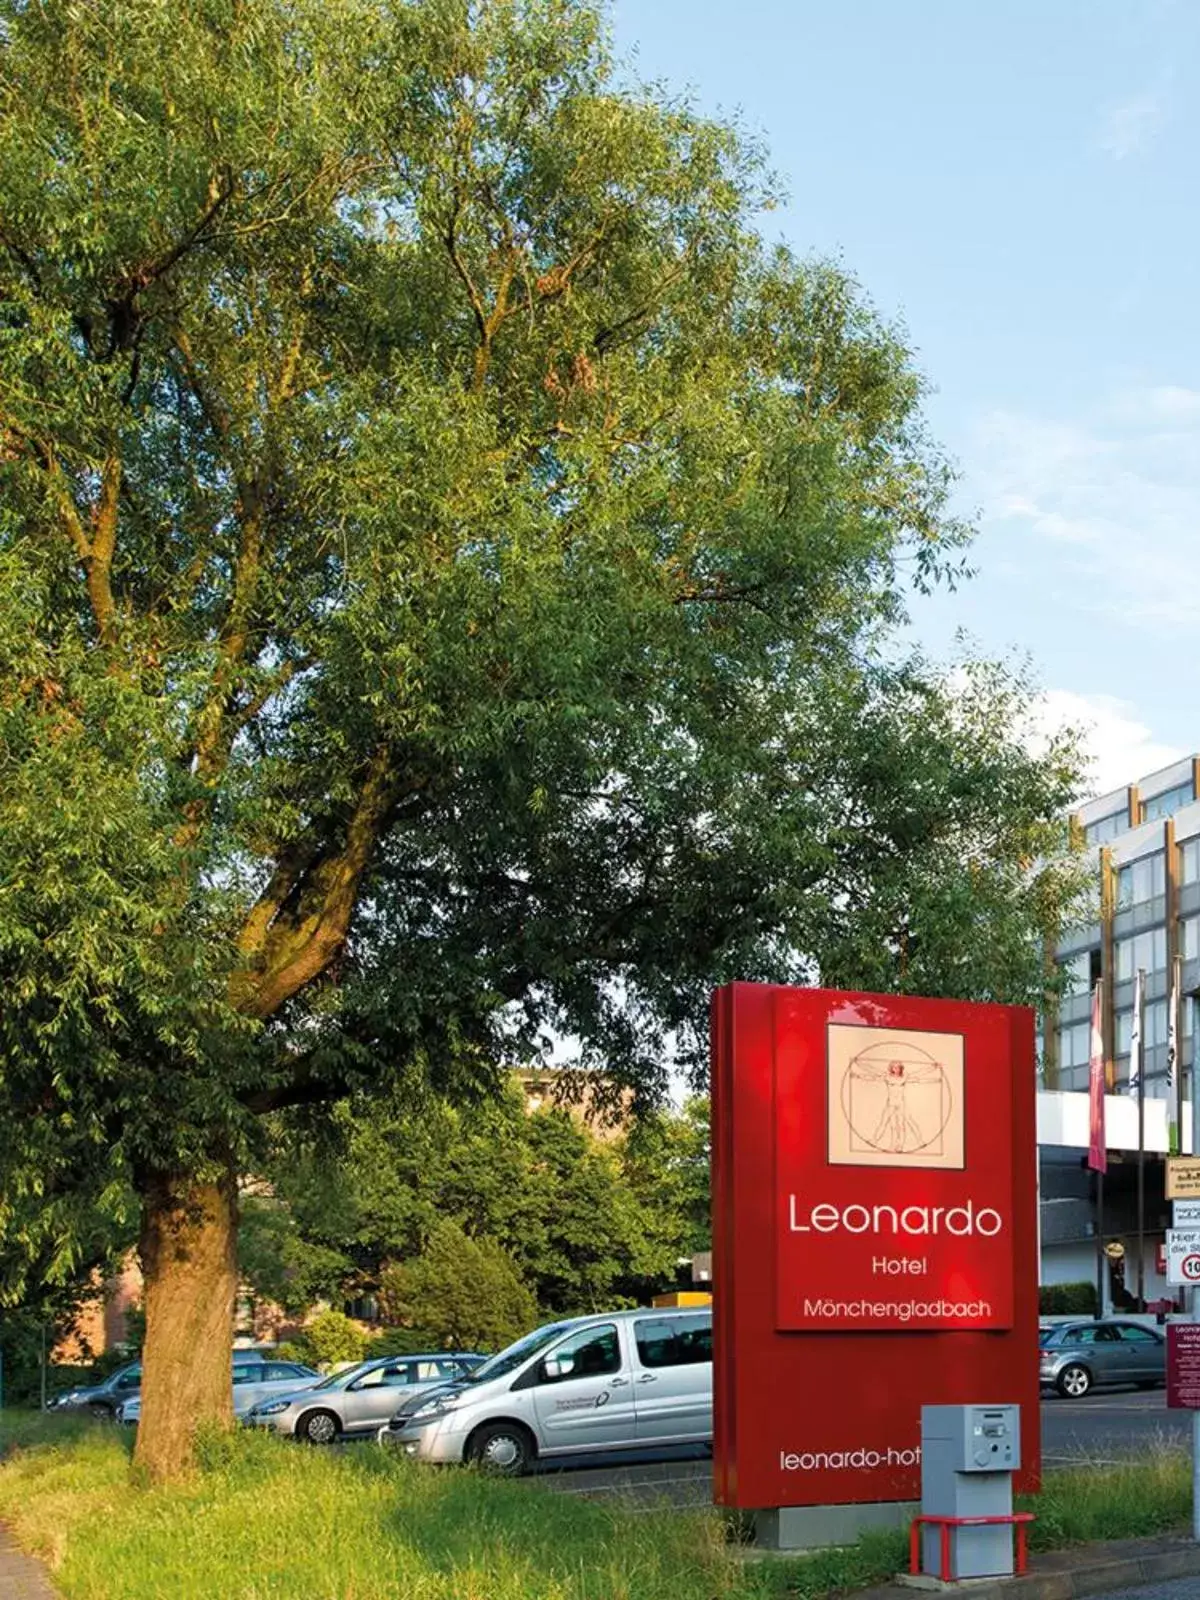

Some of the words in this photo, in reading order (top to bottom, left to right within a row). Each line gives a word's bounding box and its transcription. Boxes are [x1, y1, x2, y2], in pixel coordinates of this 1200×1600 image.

[789, 1193, 1003, 1237] Leonardo
[1171, 1232, 1196, 1242] Hier
[872, 1256, 928, 1275] Hotel
[803, 1298, 992, 1321] Mönchengladbach
